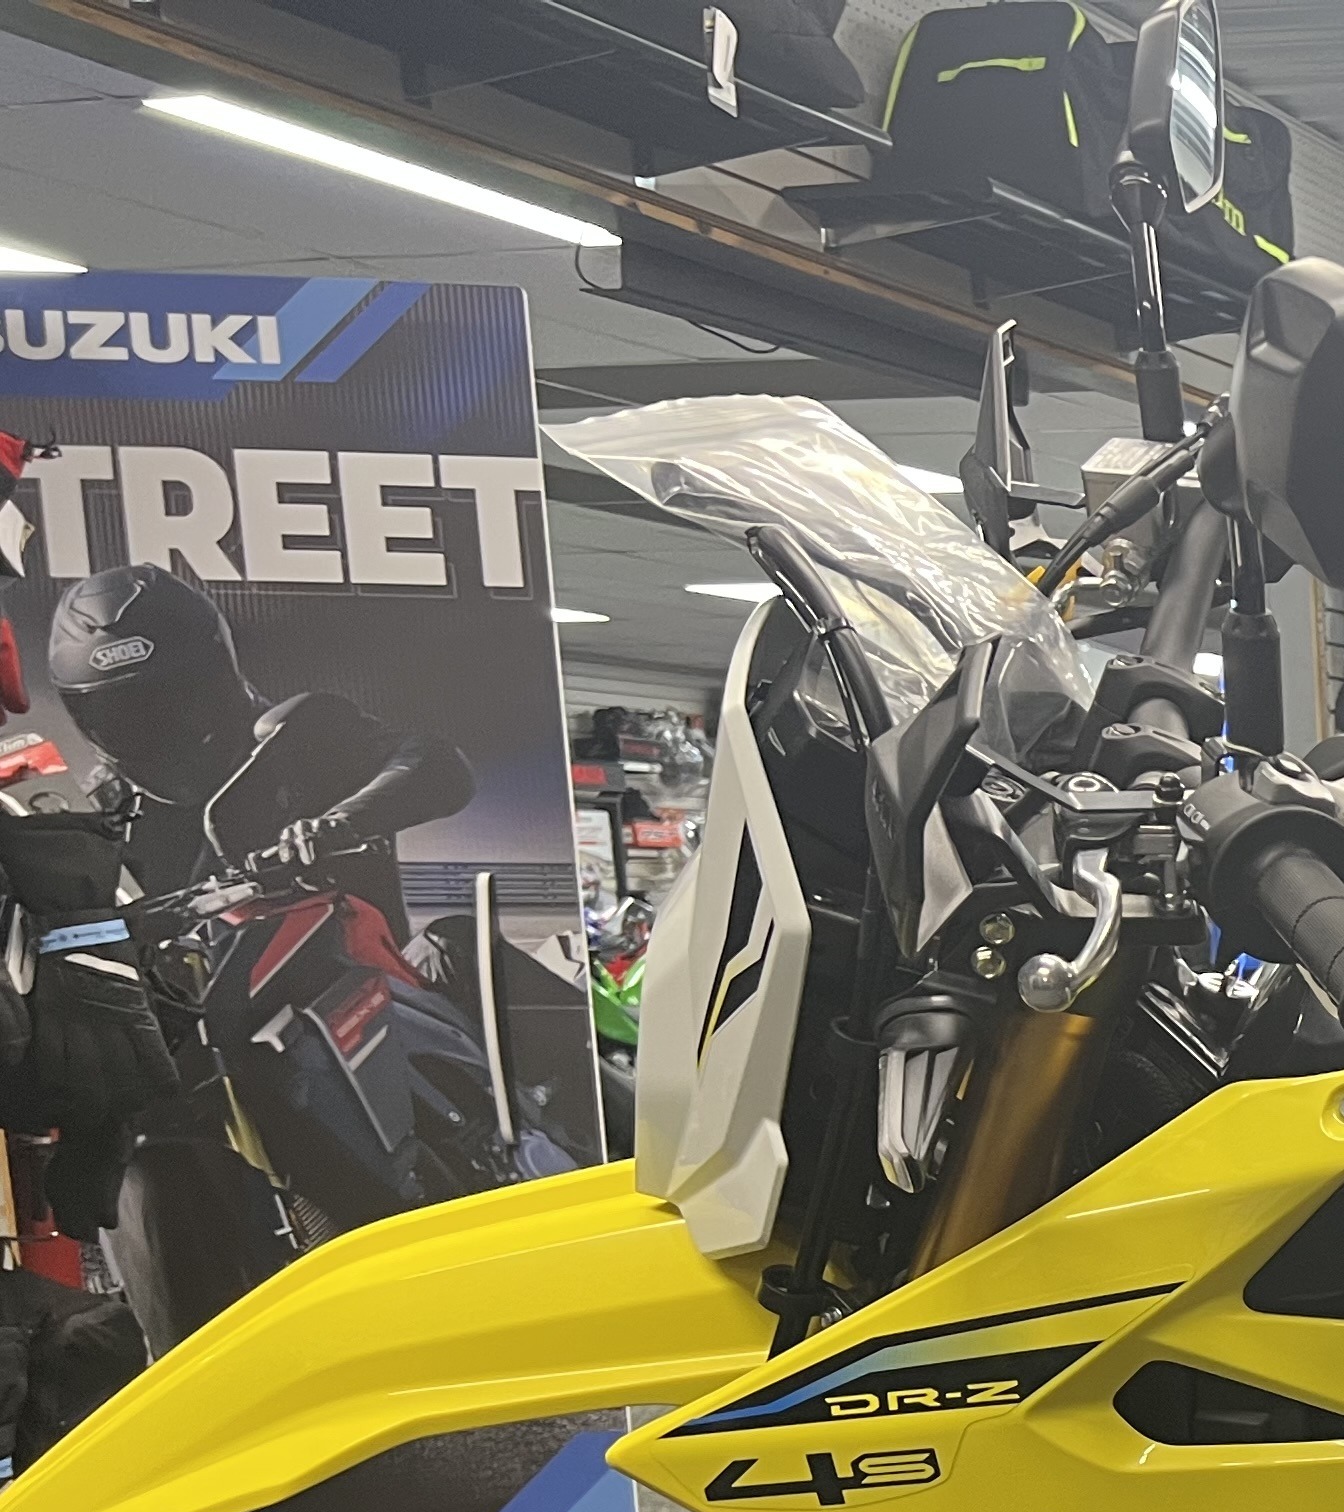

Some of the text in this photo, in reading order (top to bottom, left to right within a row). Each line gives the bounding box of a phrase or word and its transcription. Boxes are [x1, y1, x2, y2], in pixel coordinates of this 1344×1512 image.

[0, 309, 281, 364] UZUKI
[22, 445, 541, 588] TREET
[96, 639, 147, 666] SHOEI
[824, 1379, 1021, 1417] DR-Z
